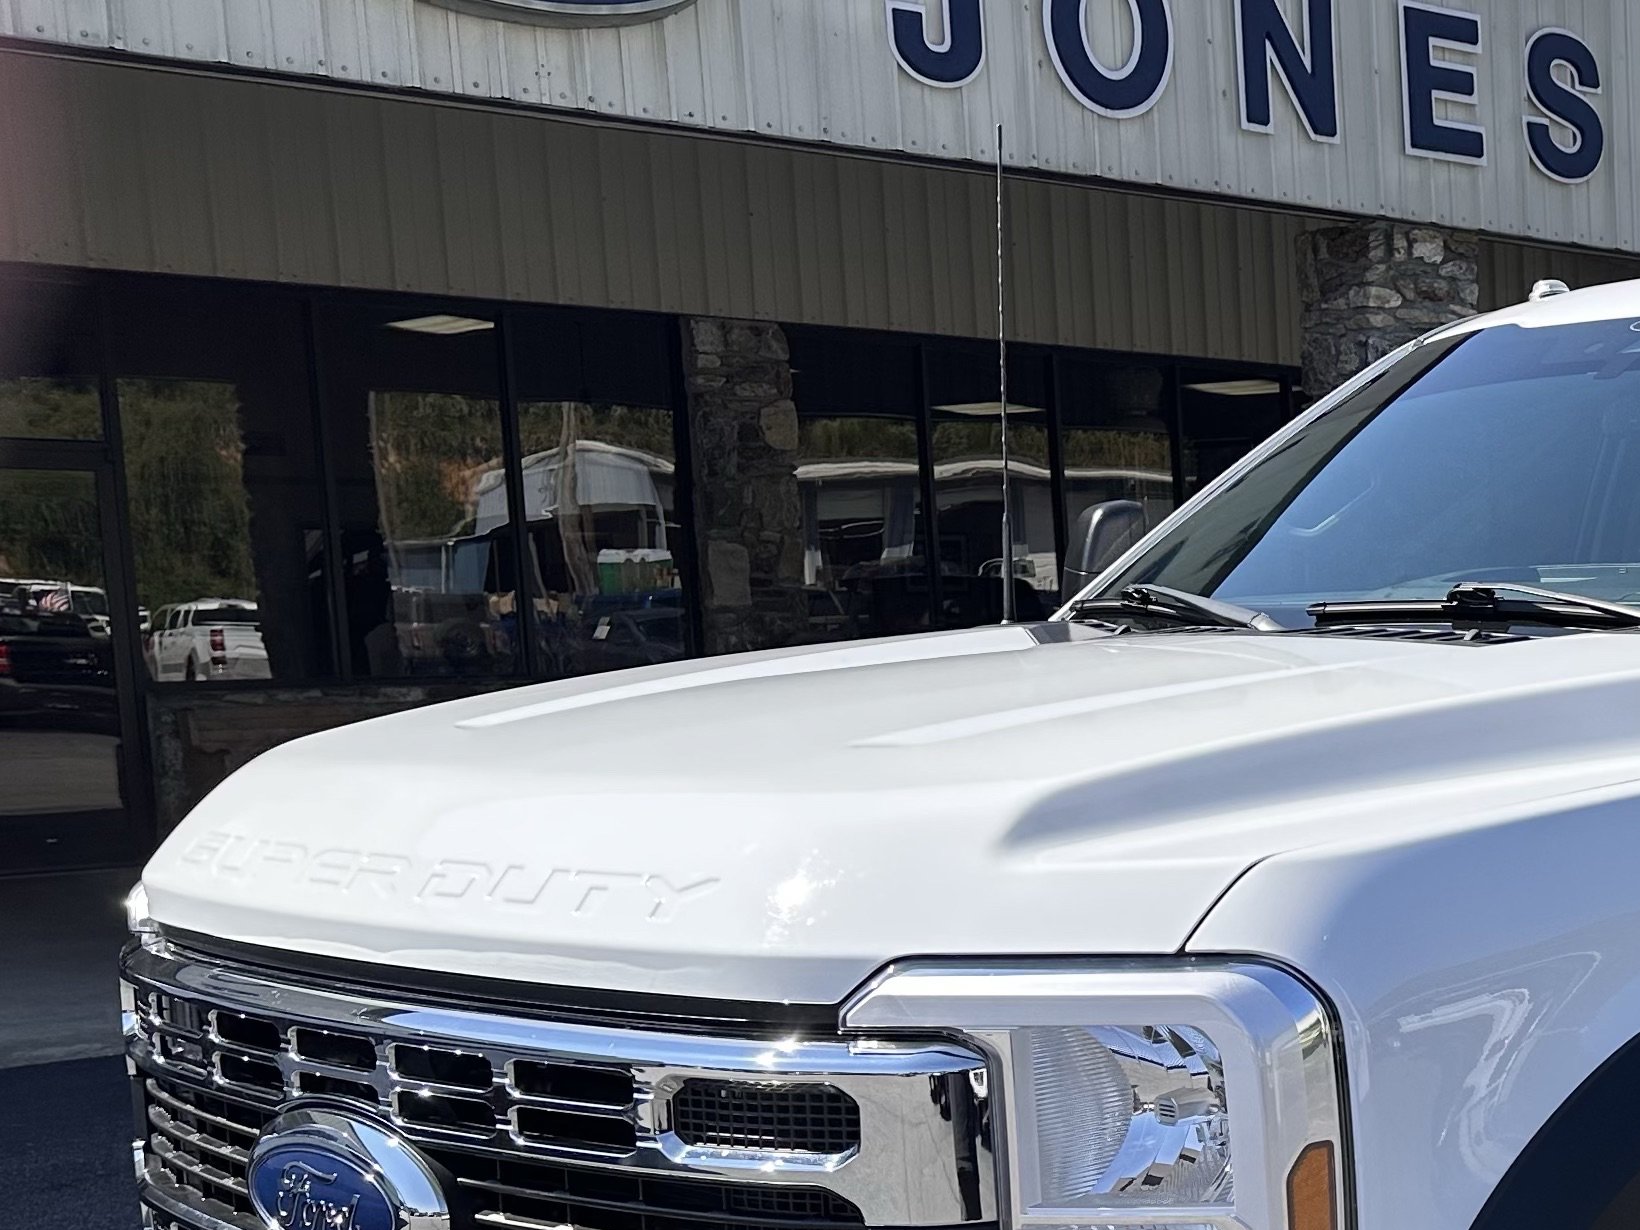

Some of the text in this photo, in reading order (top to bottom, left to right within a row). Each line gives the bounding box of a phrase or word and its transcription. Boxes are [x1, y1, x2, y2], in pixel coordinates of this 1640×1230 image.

[886, 0, 1604, 184] JONES
[176, 831, 722, 924] SUPER DUTY
